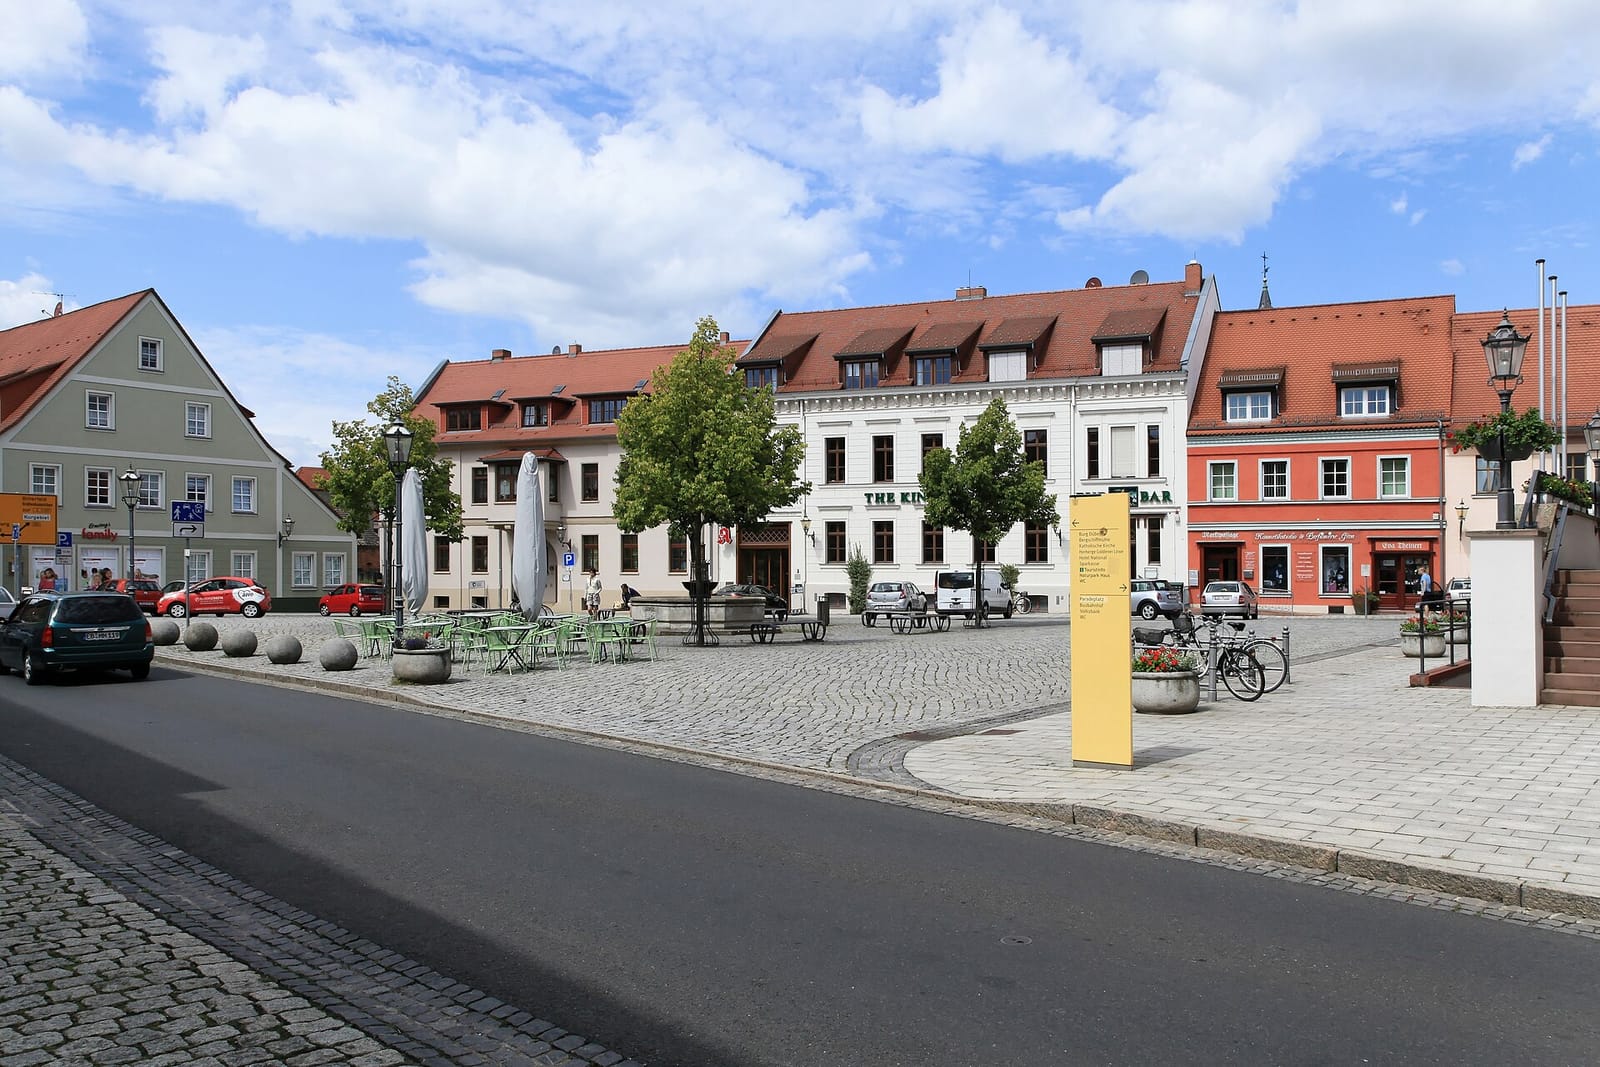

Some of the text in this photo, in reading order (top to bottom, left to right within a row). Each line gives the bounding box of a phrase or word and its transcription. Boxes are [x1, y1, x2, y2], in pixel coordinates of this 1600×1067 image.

[864, 492, 926, 504] THE KIN
[1140, 491, 1172, 503] BAR
[81, 527, 118, 542] family
[565, 554, 573, 565] P
